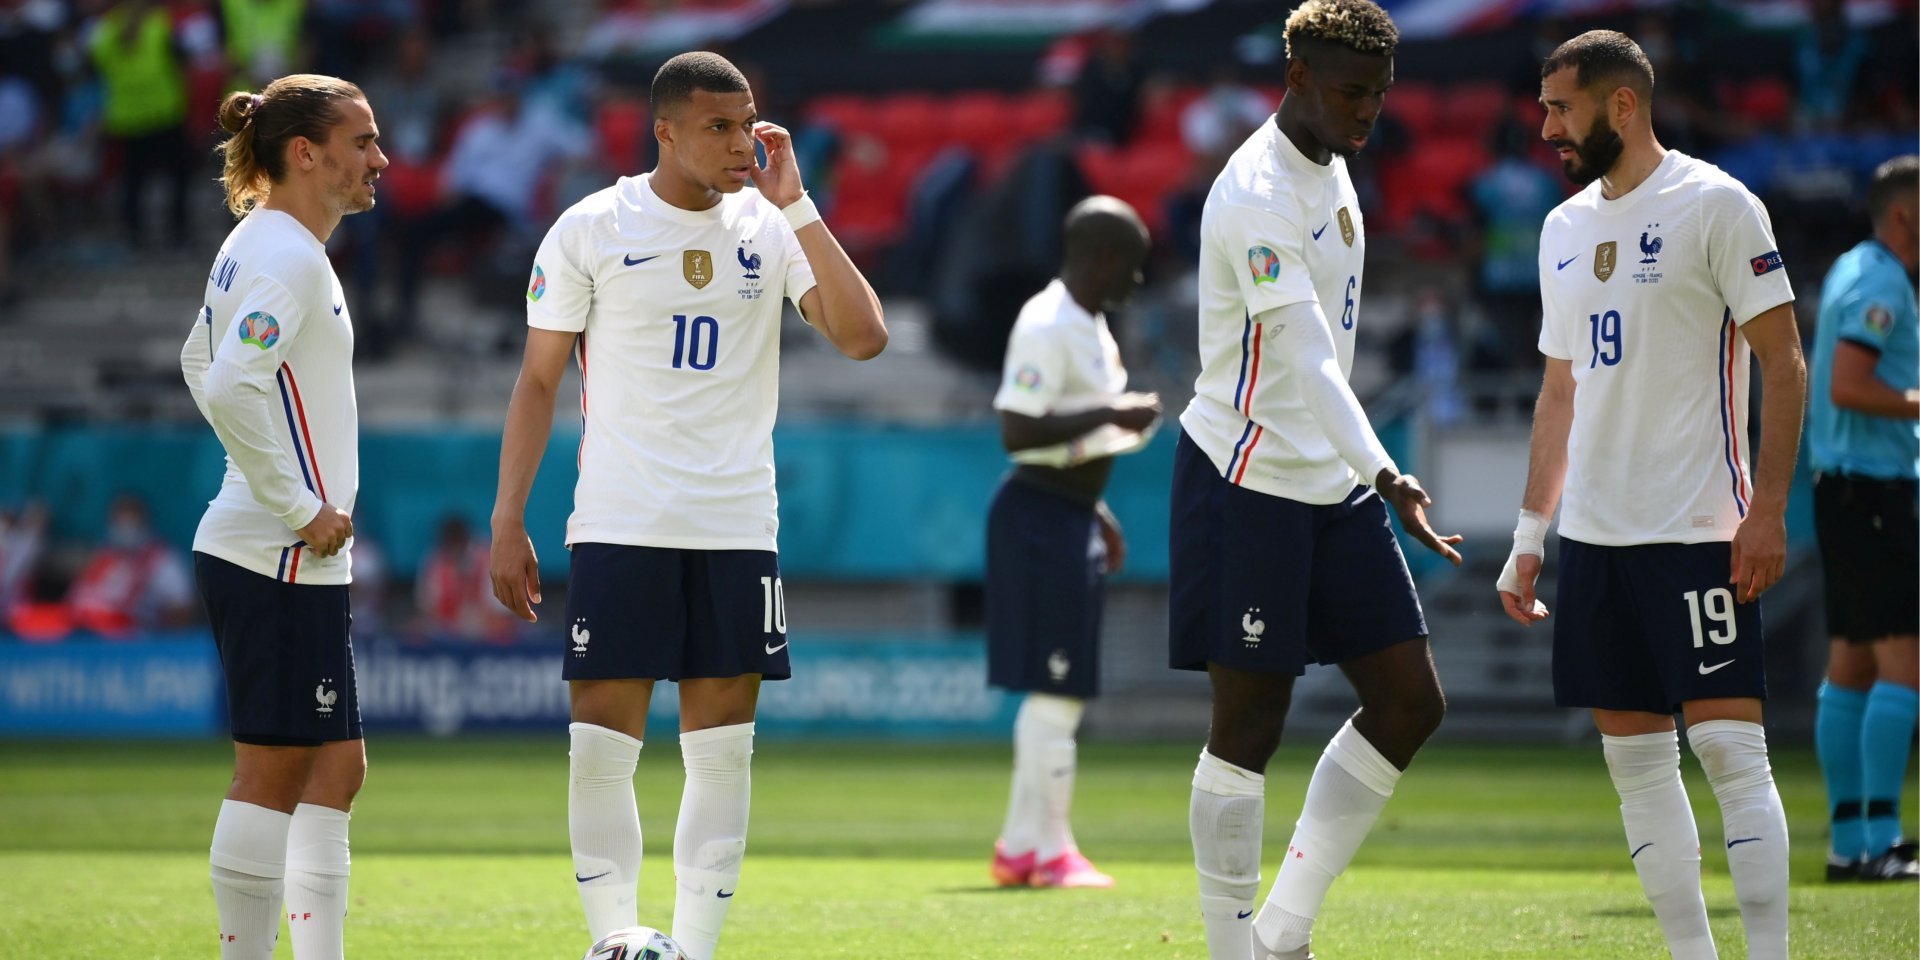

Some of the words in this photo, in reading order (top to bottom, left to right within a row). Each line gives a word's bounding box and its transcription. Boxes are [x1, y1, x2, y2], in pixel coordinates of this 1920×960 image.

[1341, 275, 1356, 331] 6
[672, 314, 719, 371] 10
[1590, 309, 1622, 369] 19
[760, 576, 787, 634] 10
[1683, 587, 1738, 648] 19
